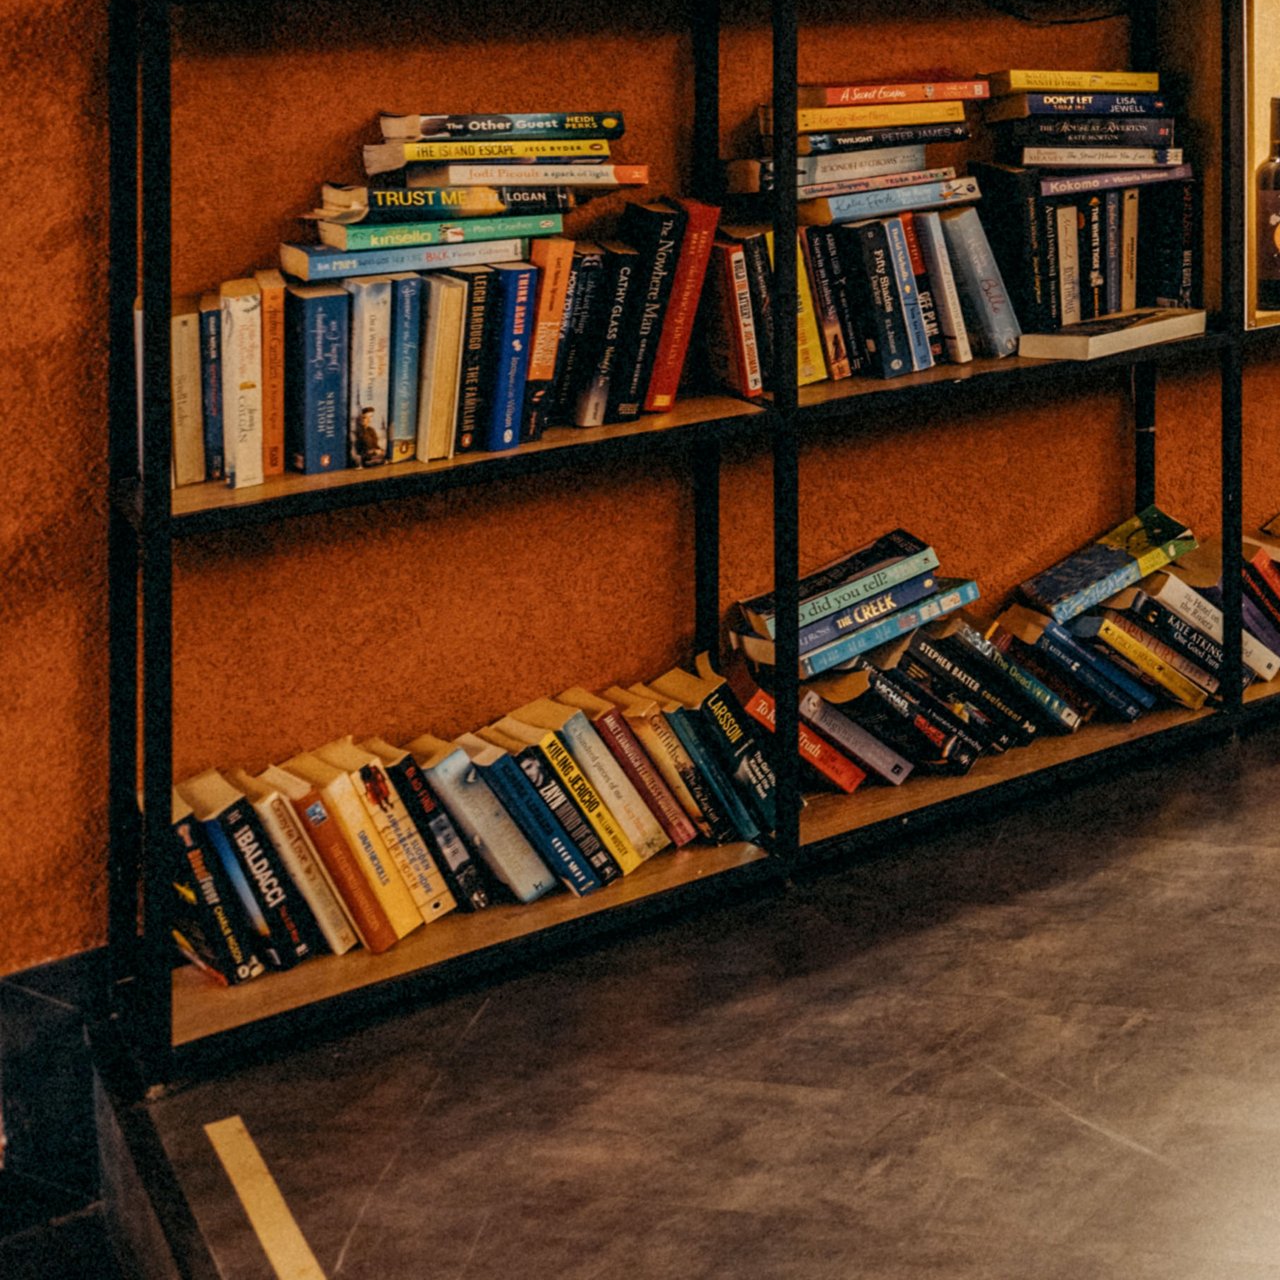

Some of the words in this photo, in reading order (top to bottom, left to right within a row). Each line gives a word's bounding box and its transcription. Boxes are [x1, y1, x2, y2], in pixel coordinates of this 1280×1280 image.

[840, 89, 849, 102] A
[851, 88, 876, 101] Secret
[1043, 96, 1075, 105] DON'T
[1076, 96, 1093, 104] LET
[1109, 105, 1146, 113] JEWELL
[1116, 97, 1137, 105] LISA
[446, 121, 463, 130] The
[468, 119, 512, 131] Other
[515, 118, 559, 130] Guest
[564, 122, 598, 130] PERKS
[836, 136, 874, 146] TWILIGHT
[881, 131, 914, 142] PETER
[917, 128, 951, 139] JAMES
[1055, 122, 1089, 133] HOUSE
[1101, 122, 1148, 132] RIVERTON
[416, 146, 434, 157] THE
[438, 145, 475, 157] ISLAND
[479, 143, 516, 156] ESCAPE
[468, 169, 495, 180] Jodi
[497, 169, 541, 179] Picoult
[1050, 179, 1100, 194] Kokomo
[373, 191, 436, 206] TRUST
[441, 190, 467, 205] ME
[506, 192, 547, 202] LOGAN
[660, 219, 673, 238] The
[1091, 206, 1099, 222] THE
[370, 231, 432, 246] kinsella
[1091, 223, 1100, 246] WHITE
[646, 237, 675, 303] Nowhere
[873, 249, 886, 274] Fifty
[1092, 248, 1100, 269] TIGER
[472, 274, 488, 304] LEIGH
[516, 272, 530, 304] THINK
[615, 266, 631, 304] CATHY
[871, 274, 882, 306] Darker
[879, 276, 895, 313] Shades
[1063, 287, 1077, 314] THOMAS
[468, 305, 485, 351] BARDUGO
[513, 305, 526, 336] AGAIN
[606, 304, 624, 341] GLASS
[639, 301, 661, 338] Man
[466, 364, 480, 384] THE
[236, 395, 249, 444] COLGAN
[462, 385, 478, 432] FAMILIAR
[806, 597, 833, 620] did
[833, 585, 862, 609] you
[861, 571, 890, 594] tell?
[835, 614, 854, 630] THE
[850, 591, 899, 626] CREEK
[1192, 597, 1214, 617] Hotel
[1166, 614, 1192, 636] KATE
[1179, 600, 1194, 614] the
[1189, 608, 1215, 631] Riviera
[1172, 630, 1189, 646] One
[1186, 641, 1206, 658] Good
[1203, 654, 1222, 671] Turn
[917, 641, 954, 672] STEPHEN
[949, 665, 982, 693] BAXTER
[705, 692, 745, 744] LARSSON
[753, 698, 772, 717] To
[795, 729, 824, 759] Truth
[602, 713, 623, 736] JANET
[614, 731, 644, 769] EVANOVICH
[647, 712, 685, 764] Griffiths
[544, 738, 577, 778] KILLING
[567, 771, 602, 814] JERICHO
[753, 750, 765, 764] The
[759, 761, 771, 774] Girl
[538, 779, 568, 811] ZAYN
[234, 825, 285, 908] BALDACCI
[383, 812, 419, 865] APPEARANCE
[416, 872, 434, 895] HOPE
[409, 839, 432, 871] SUDDEN
[398, 858, 422, 891] NORTH
[212, 905, 232, 936] CHARLIE
[225, 935, 244, 964] HIGSON
